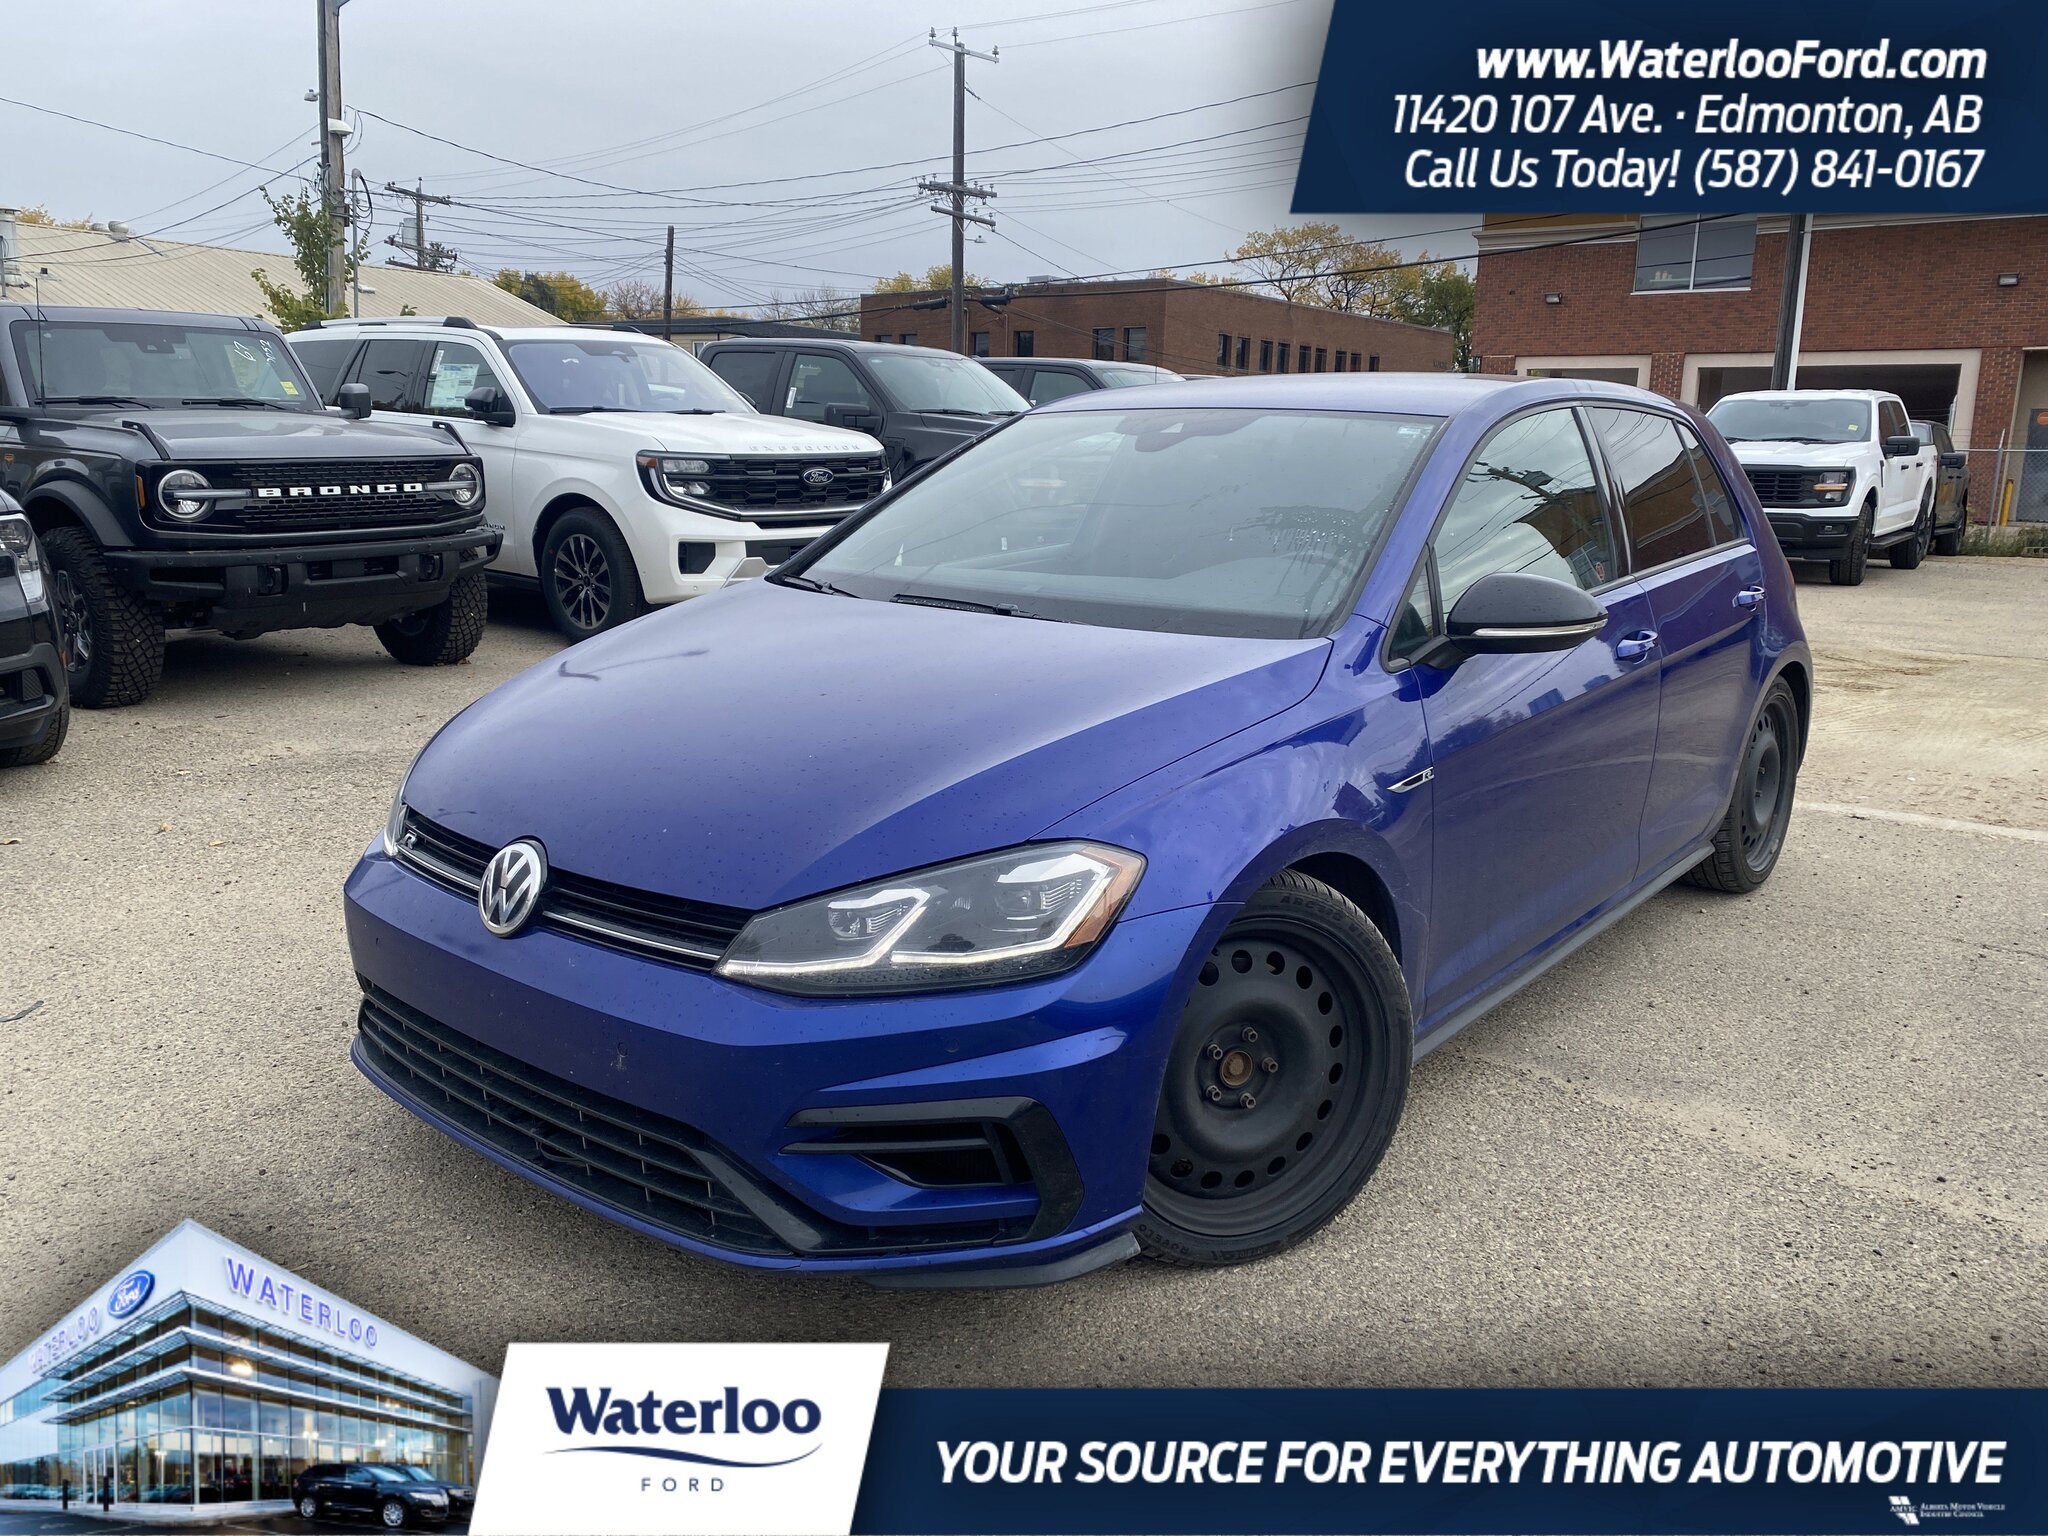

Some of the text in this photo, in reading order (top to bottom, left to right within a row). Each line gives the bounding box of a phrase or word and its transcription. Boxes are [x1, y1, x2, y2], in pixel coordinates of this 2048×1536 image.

[748, 443, 861, 452] EXPEDITION
[808, 470, 830, 483] Ford
[257, 482, 423, 498] BRONCO
[403, 832, 419, 850] R
